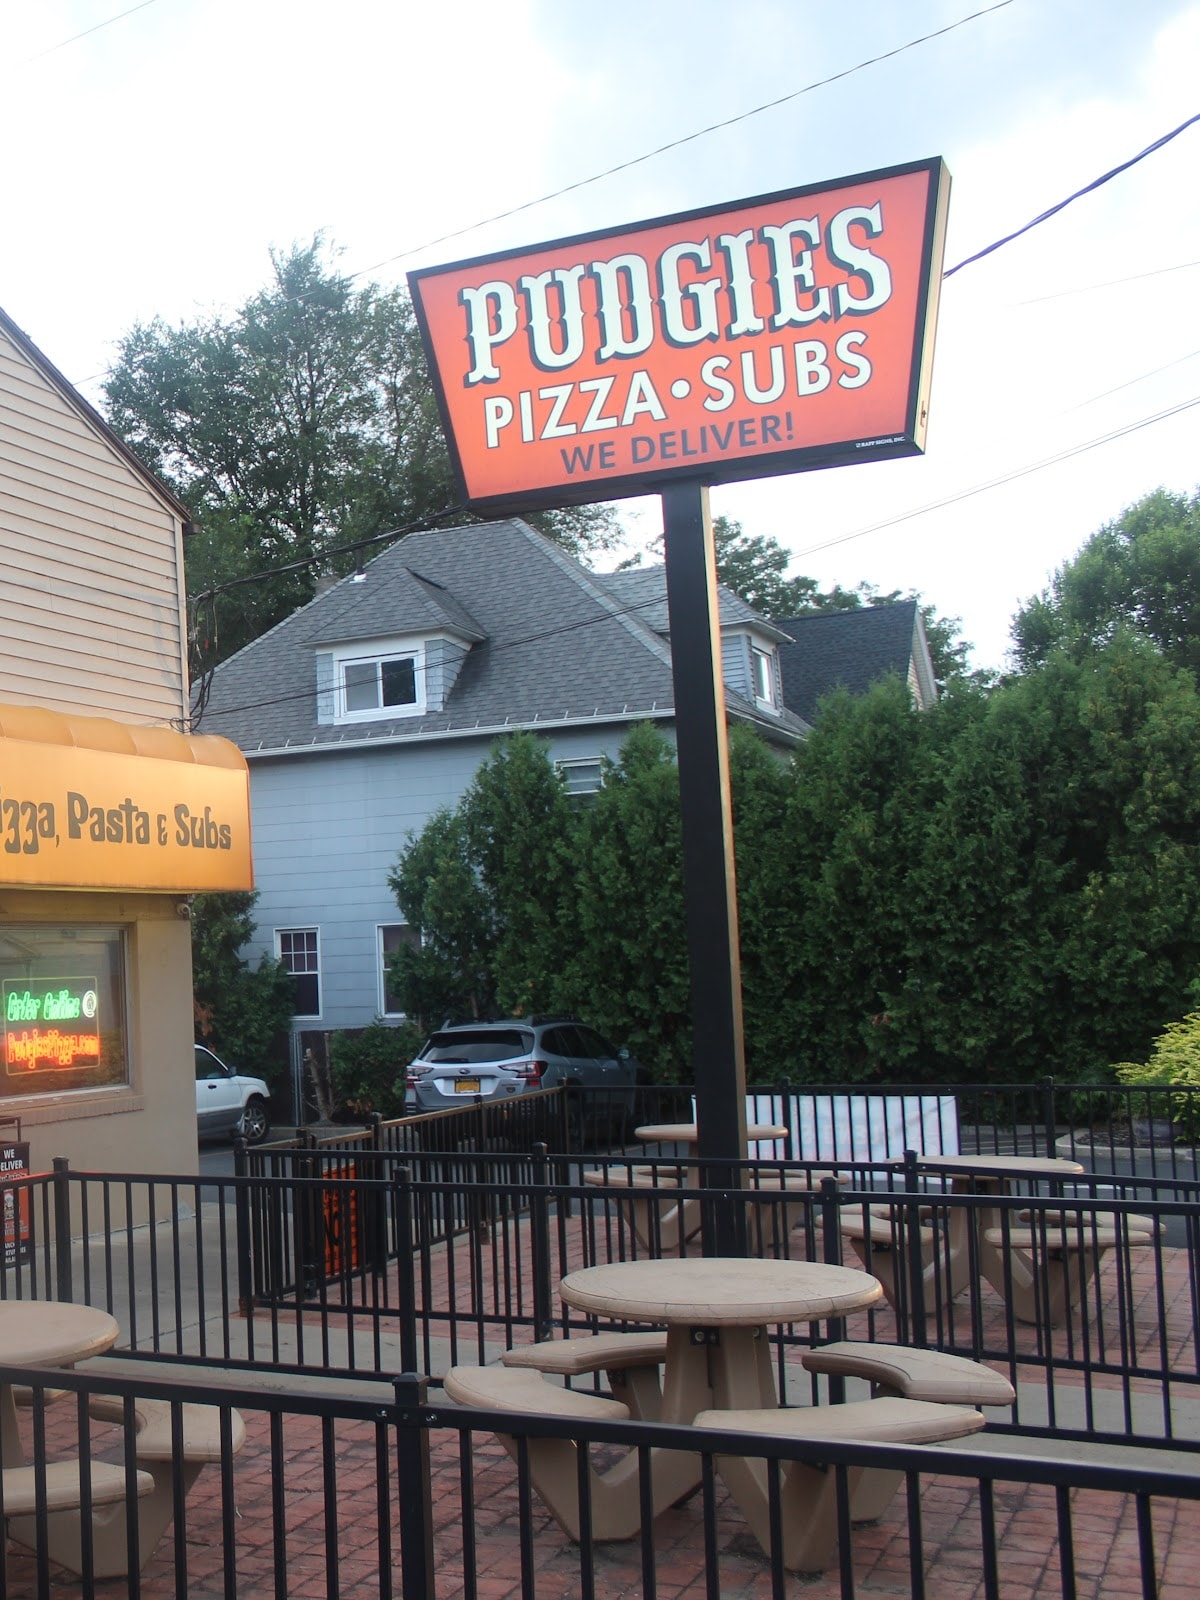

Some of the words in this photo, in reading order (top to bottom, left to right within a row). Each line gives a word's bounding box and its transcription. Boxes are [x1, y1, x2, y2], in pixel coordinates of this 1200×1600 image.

[458, 201, 893, 389] PUDGIES
[484, 370, 669, 449] PIZZA
[701, 330, 872, 412] SUBS
[560, 440, 616, 475] WE
[631, 411, 795, 465] DELIVER!
[67, 791, 150, 845] Pasta
[174, 803, 231, 850] Subs
[4, 1148, 15, 1159] WE
